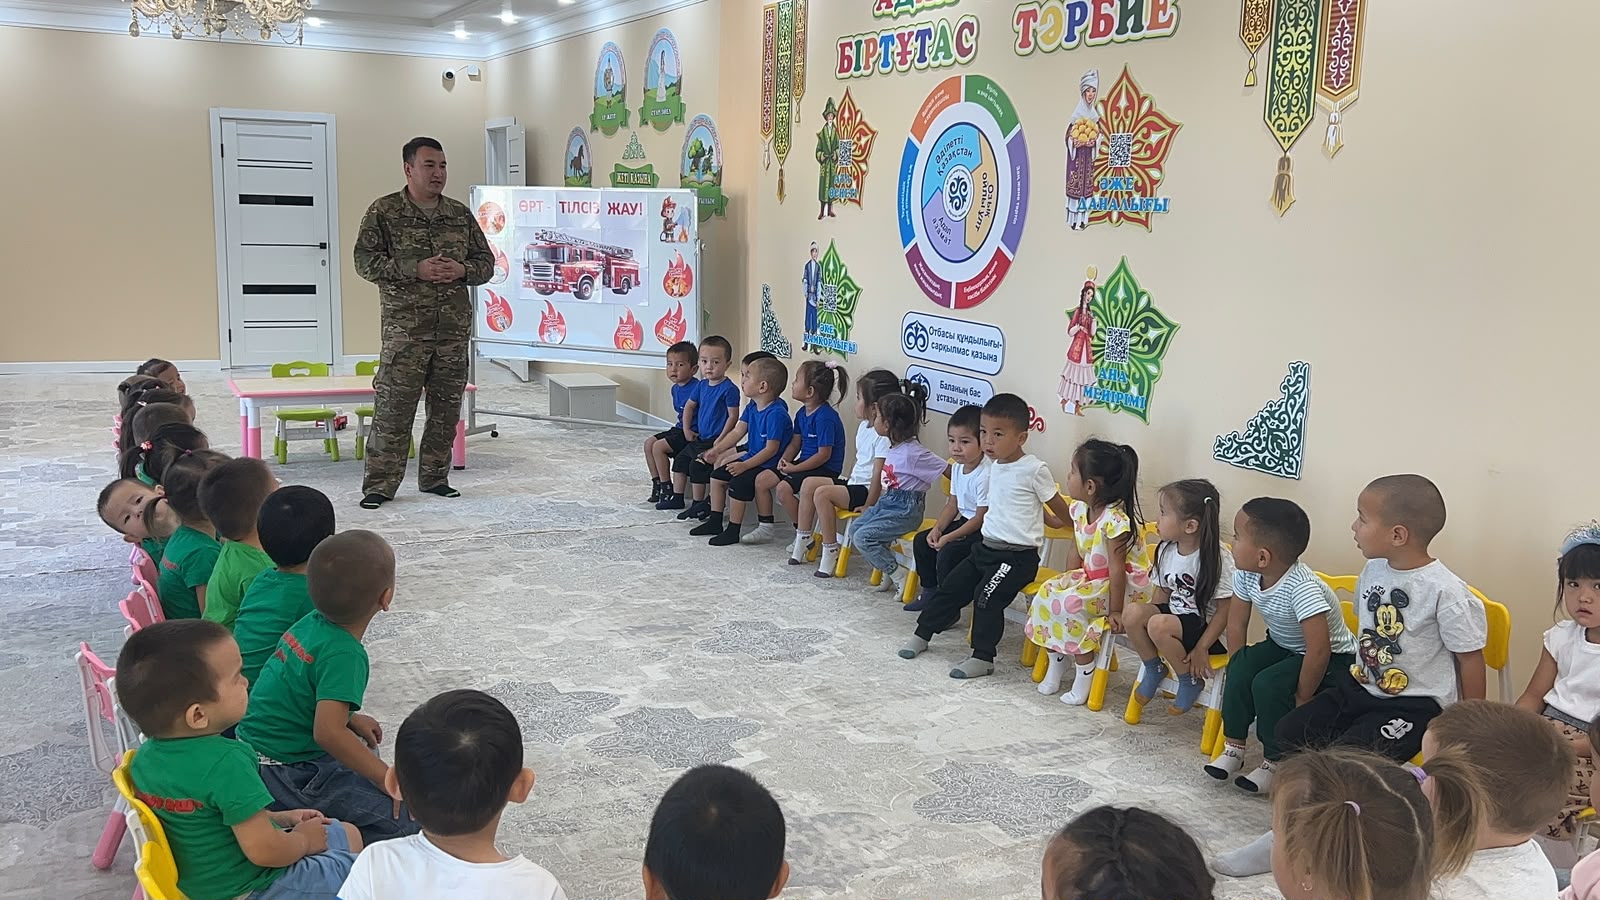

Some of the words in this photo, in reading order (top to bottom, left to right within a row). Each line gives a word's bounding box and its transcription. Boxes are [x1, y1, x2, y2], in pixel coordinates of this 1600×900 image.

[1016, 0, 1174, 48] ТӘРБИЕ
[838, 21, 975, 74] БІРТҰТАС
[935, 135, 964, 164] Әділетті
[1100, 177, 1134, 190] ӘЖЕ
[519, 200, 544, 212] ӨРТ
[559, 201, 600, 214] ТІЛСІЗ
[608, 202, 643, 216] ЖАУ!
[1076, 198, 1169, 212] ДАНАЛЫҒЫ
[932, 218, 951, 245] азамат
[938, 217, 951, 235] Адал
[929, 326, 955, 340] Отбасы
[956, 333, 1002, 349] құндылығы-
[931, 341, 970, 356] сарқылмас
[971, 349, 998, 363] қазына
[1098, 368, 1128, 383] АНА
[936, 393, 958, 404] ұстазы
[940, 380, 969, 396] Баланың
[969, 387, 981, 398] бас
[1083, 386, 1146, 408] МЕЙІРІМІ
